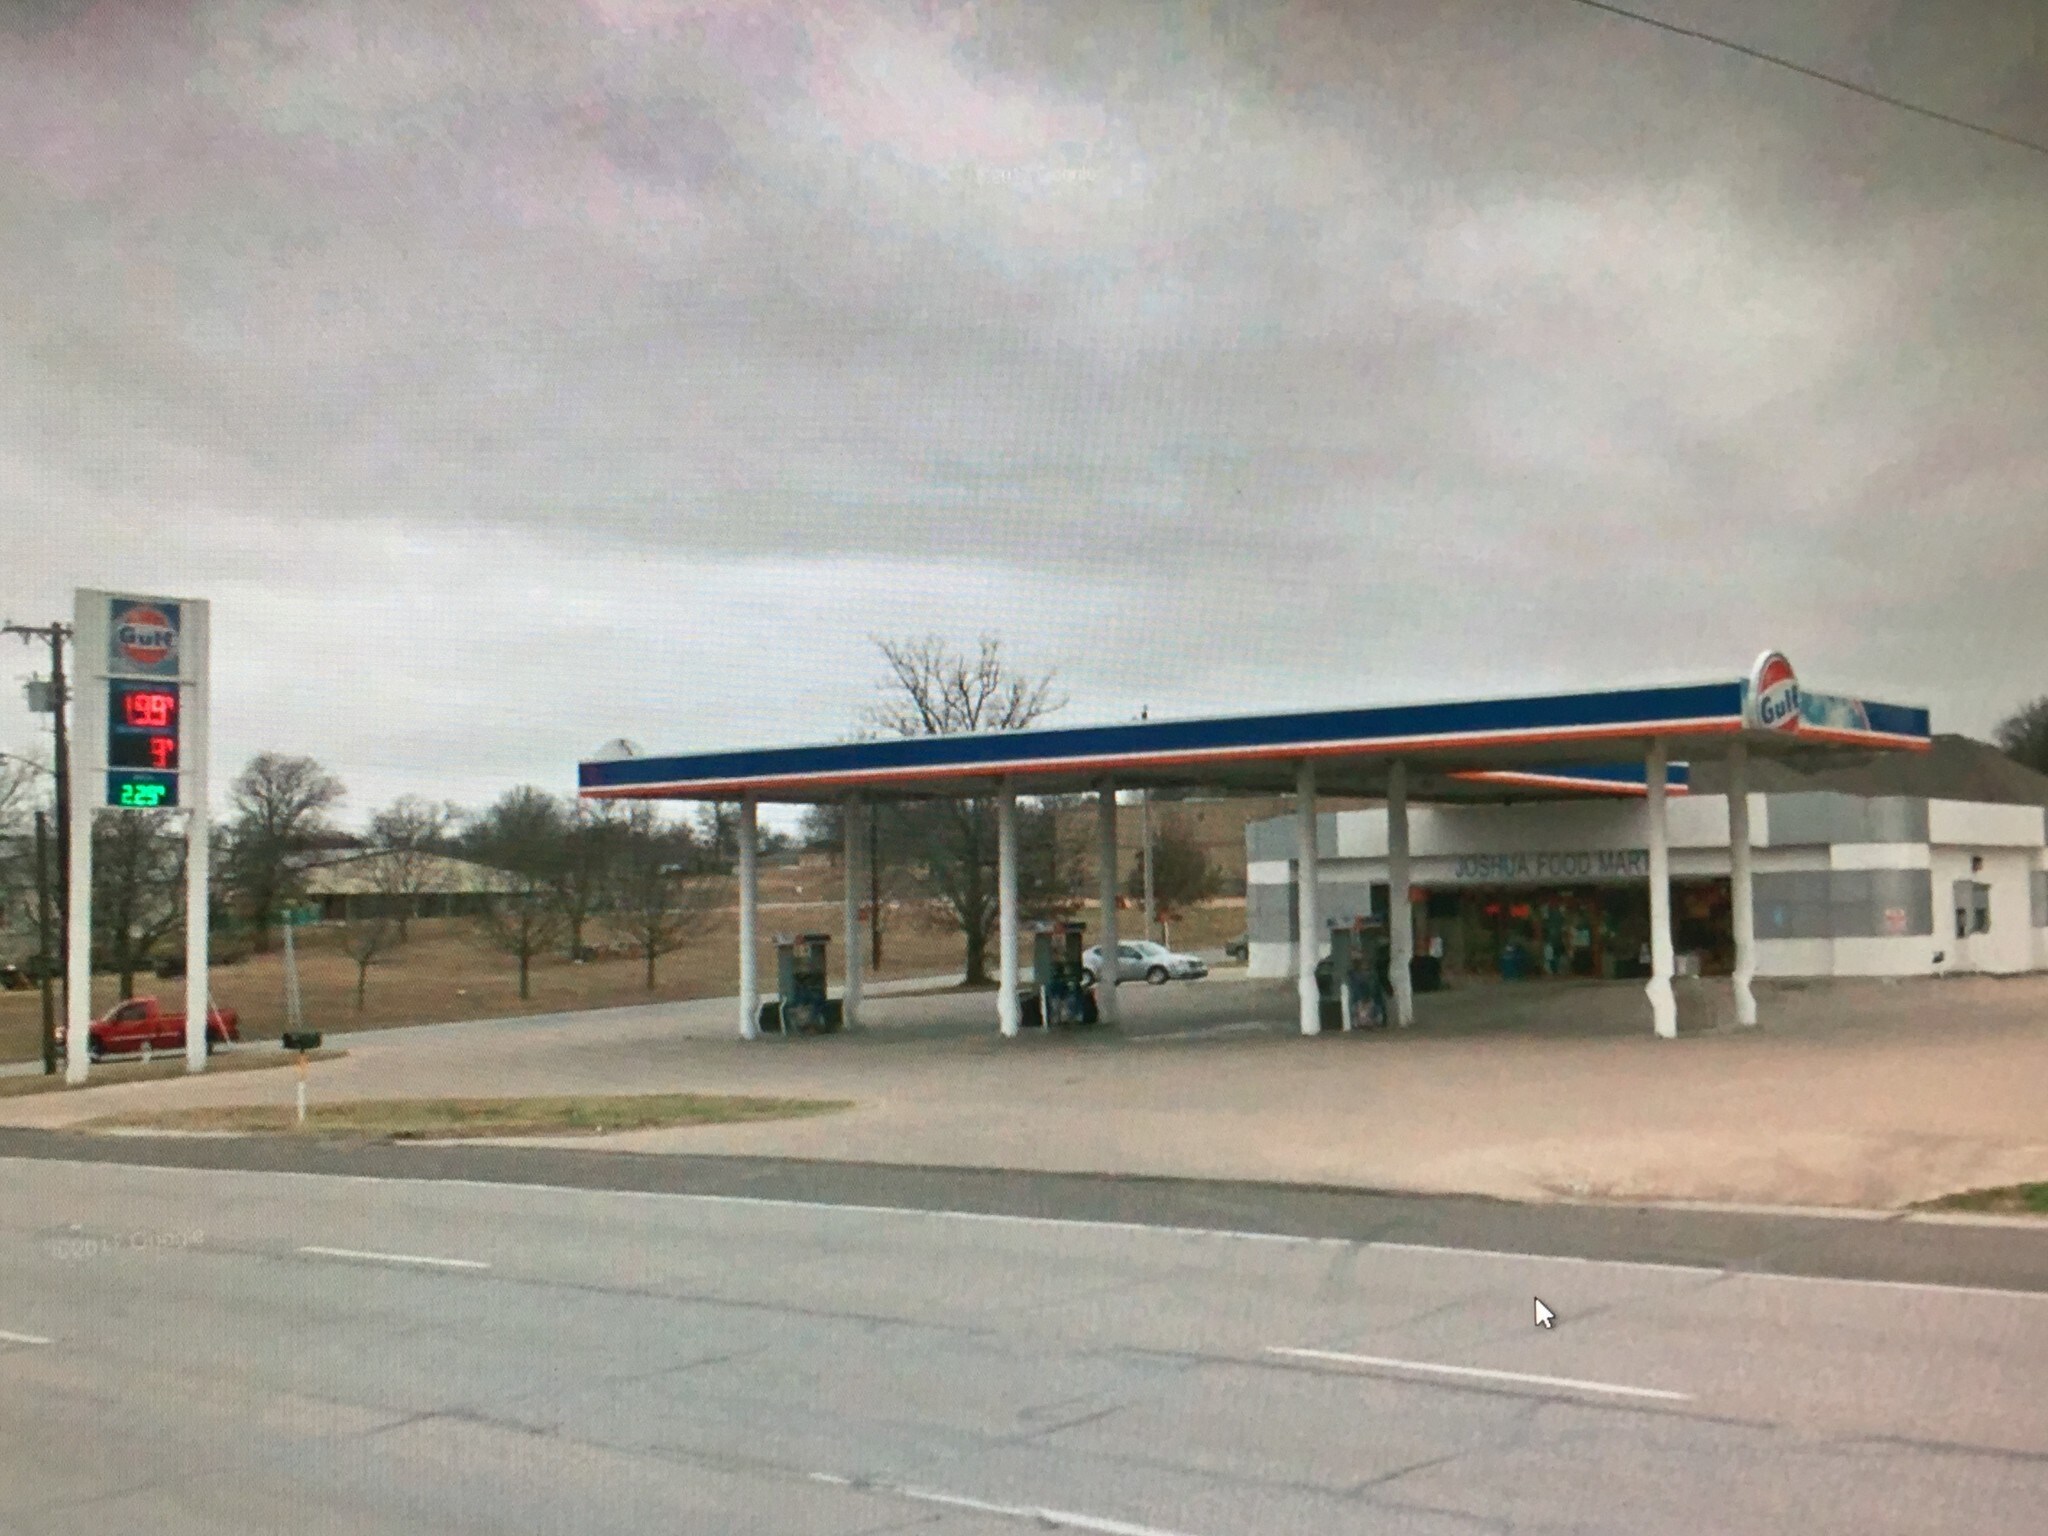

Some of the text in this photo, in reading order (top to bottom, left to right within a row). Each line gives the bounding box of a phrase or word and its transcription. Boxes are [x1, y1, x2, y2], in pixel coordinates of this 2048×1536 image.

[118, 625, 174, 646] Gulf
[1760, 685, 1799, 725] Gulf
[1455, 855, 1529, 878] JOSHUA
[1536, 854, 1591, 876] FOOD
